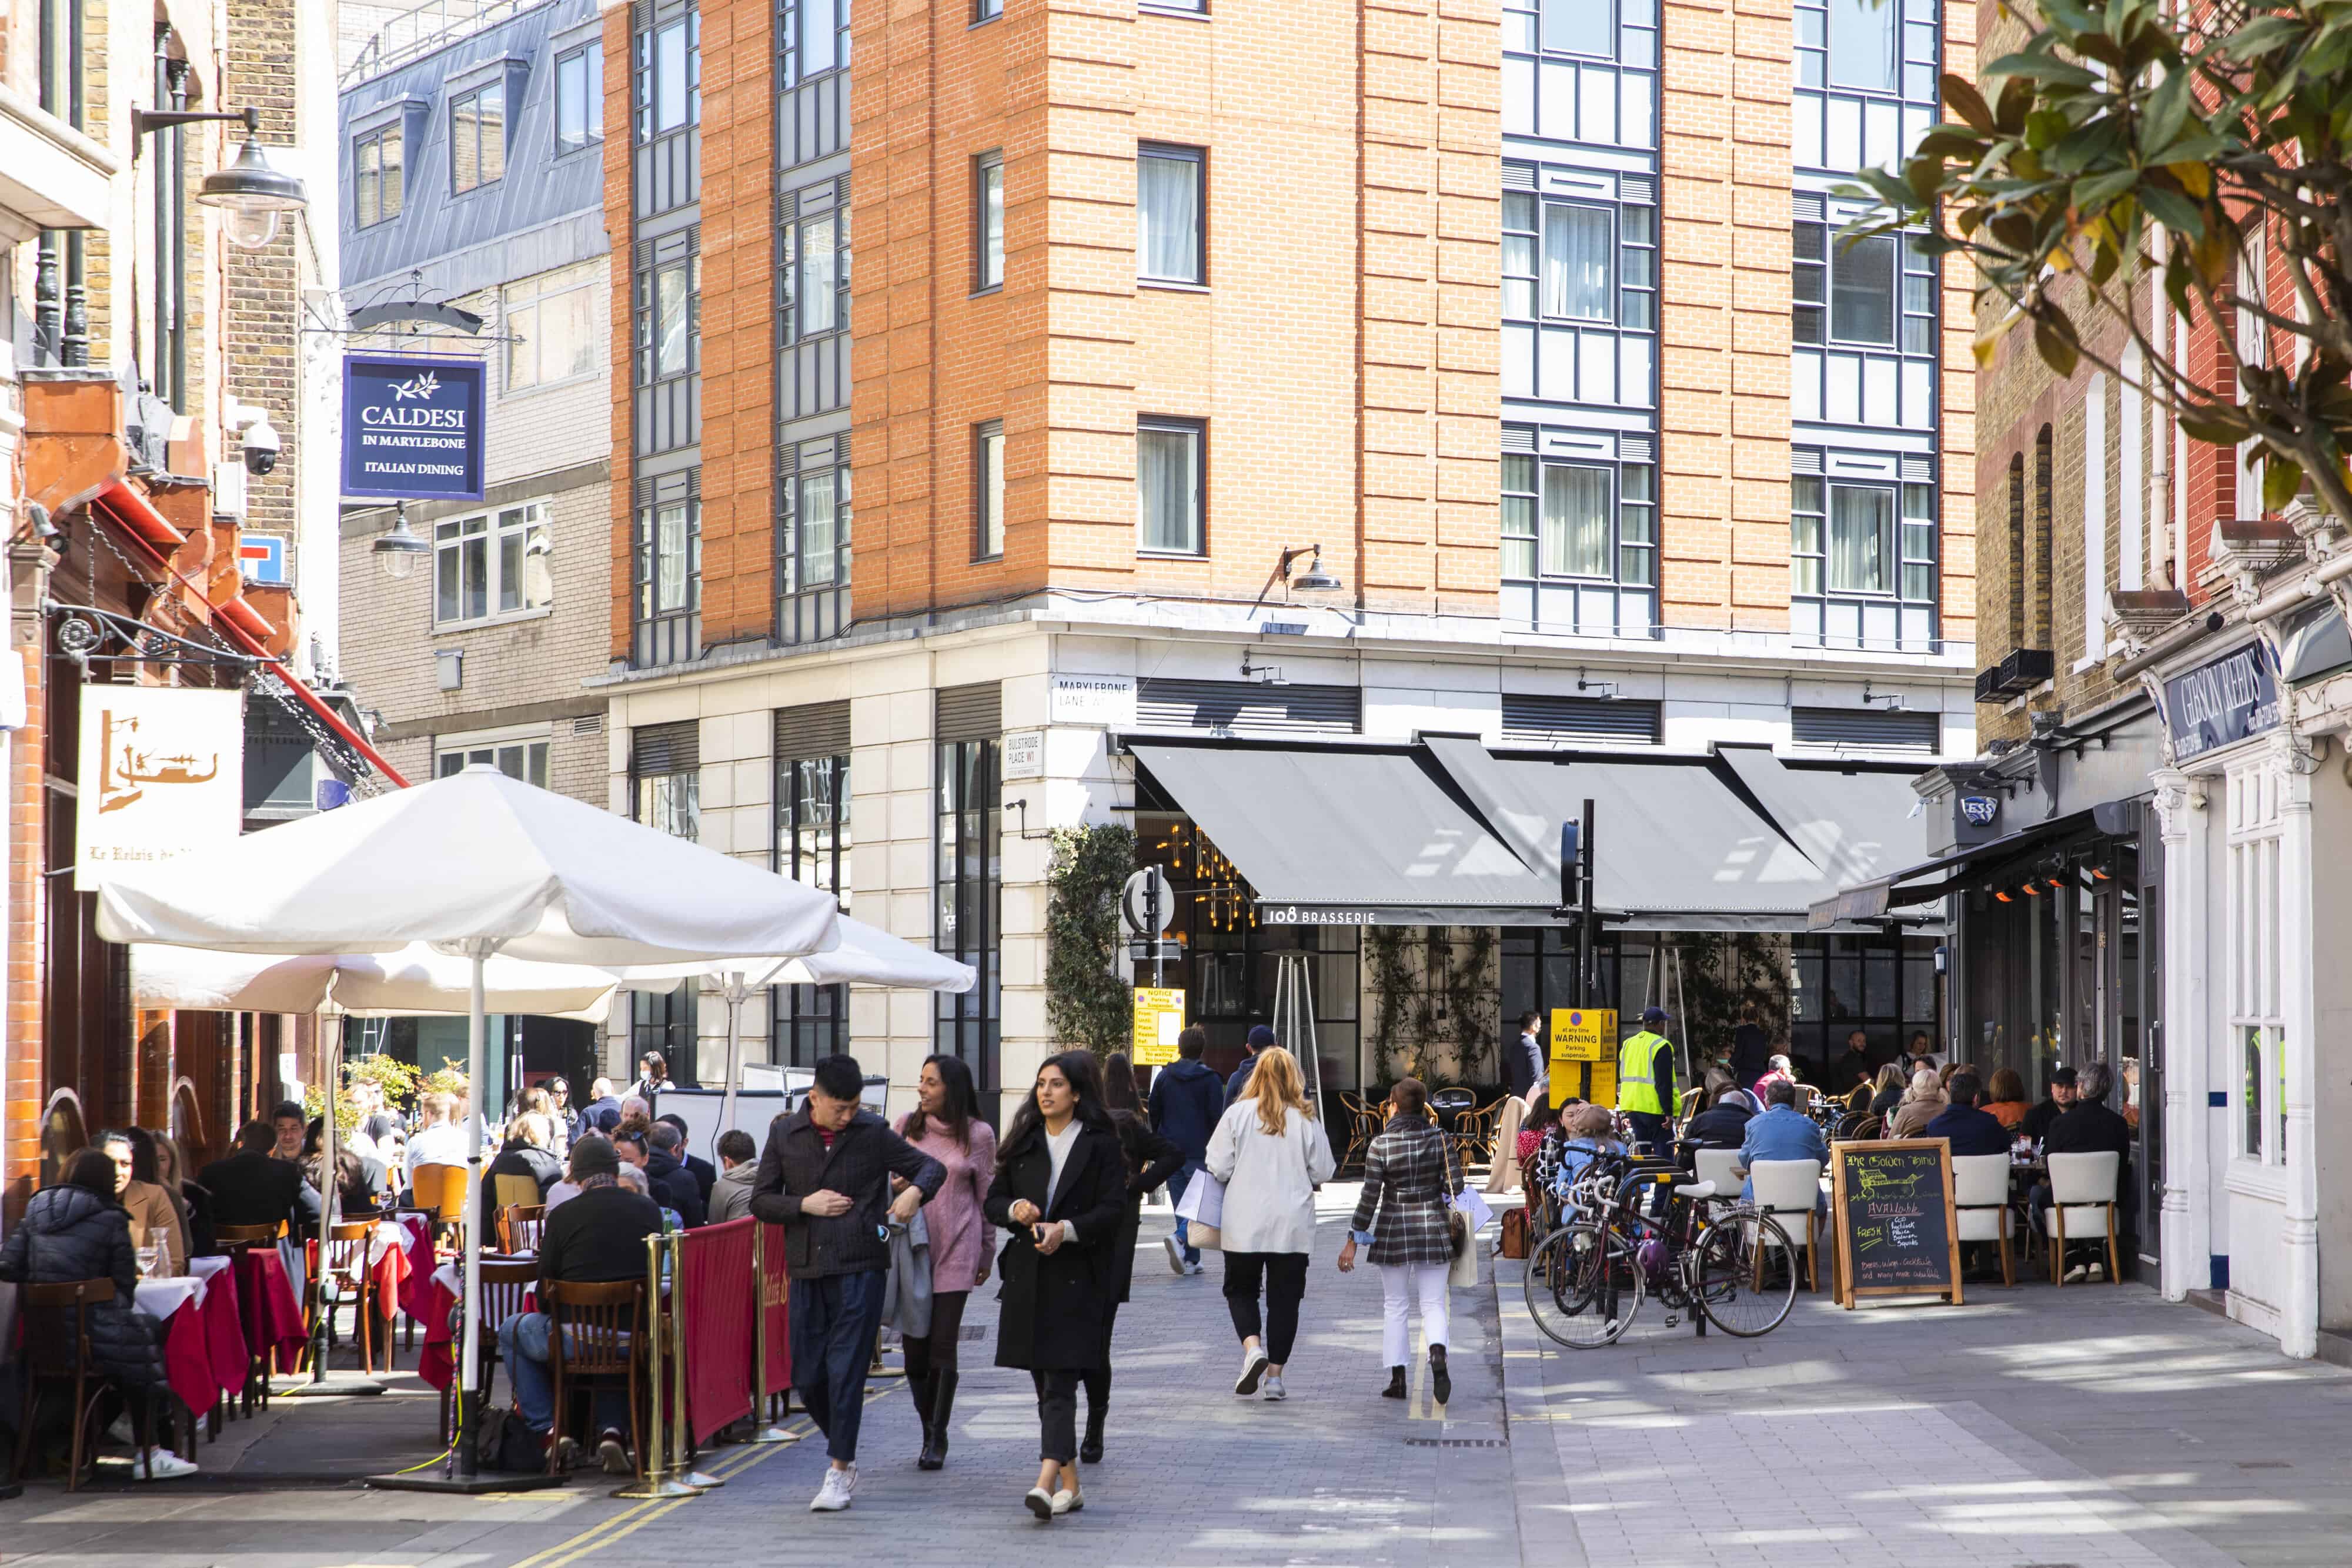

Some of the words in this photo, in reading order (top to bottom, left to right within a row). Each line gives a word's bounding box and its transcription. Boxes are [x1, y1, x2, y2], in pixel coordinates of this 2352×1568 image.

[362, 406, 466, 428] CALDESI
[362, 435, 378, 445] IN
[379, 436, 466, 449] MARYLEBONE
[365, 462, 416, 474] ITALIAN
[417, 464, 464, 476] DINING
[2181, 664, 2223, 728] GIBSON
[2220, 648, 2260, 712] REEDS
[1008, 736, 1038, 750] BULSTRODE
[1008, 751, 1025, 764] PLACE
[1269, 906, 1297, 923] 108
[1302, 912, 1375, 924] BRASSERIE
[1555, 1034, 1598, 1044] WARNING
[1845, 1155, 1865, 1168] The
